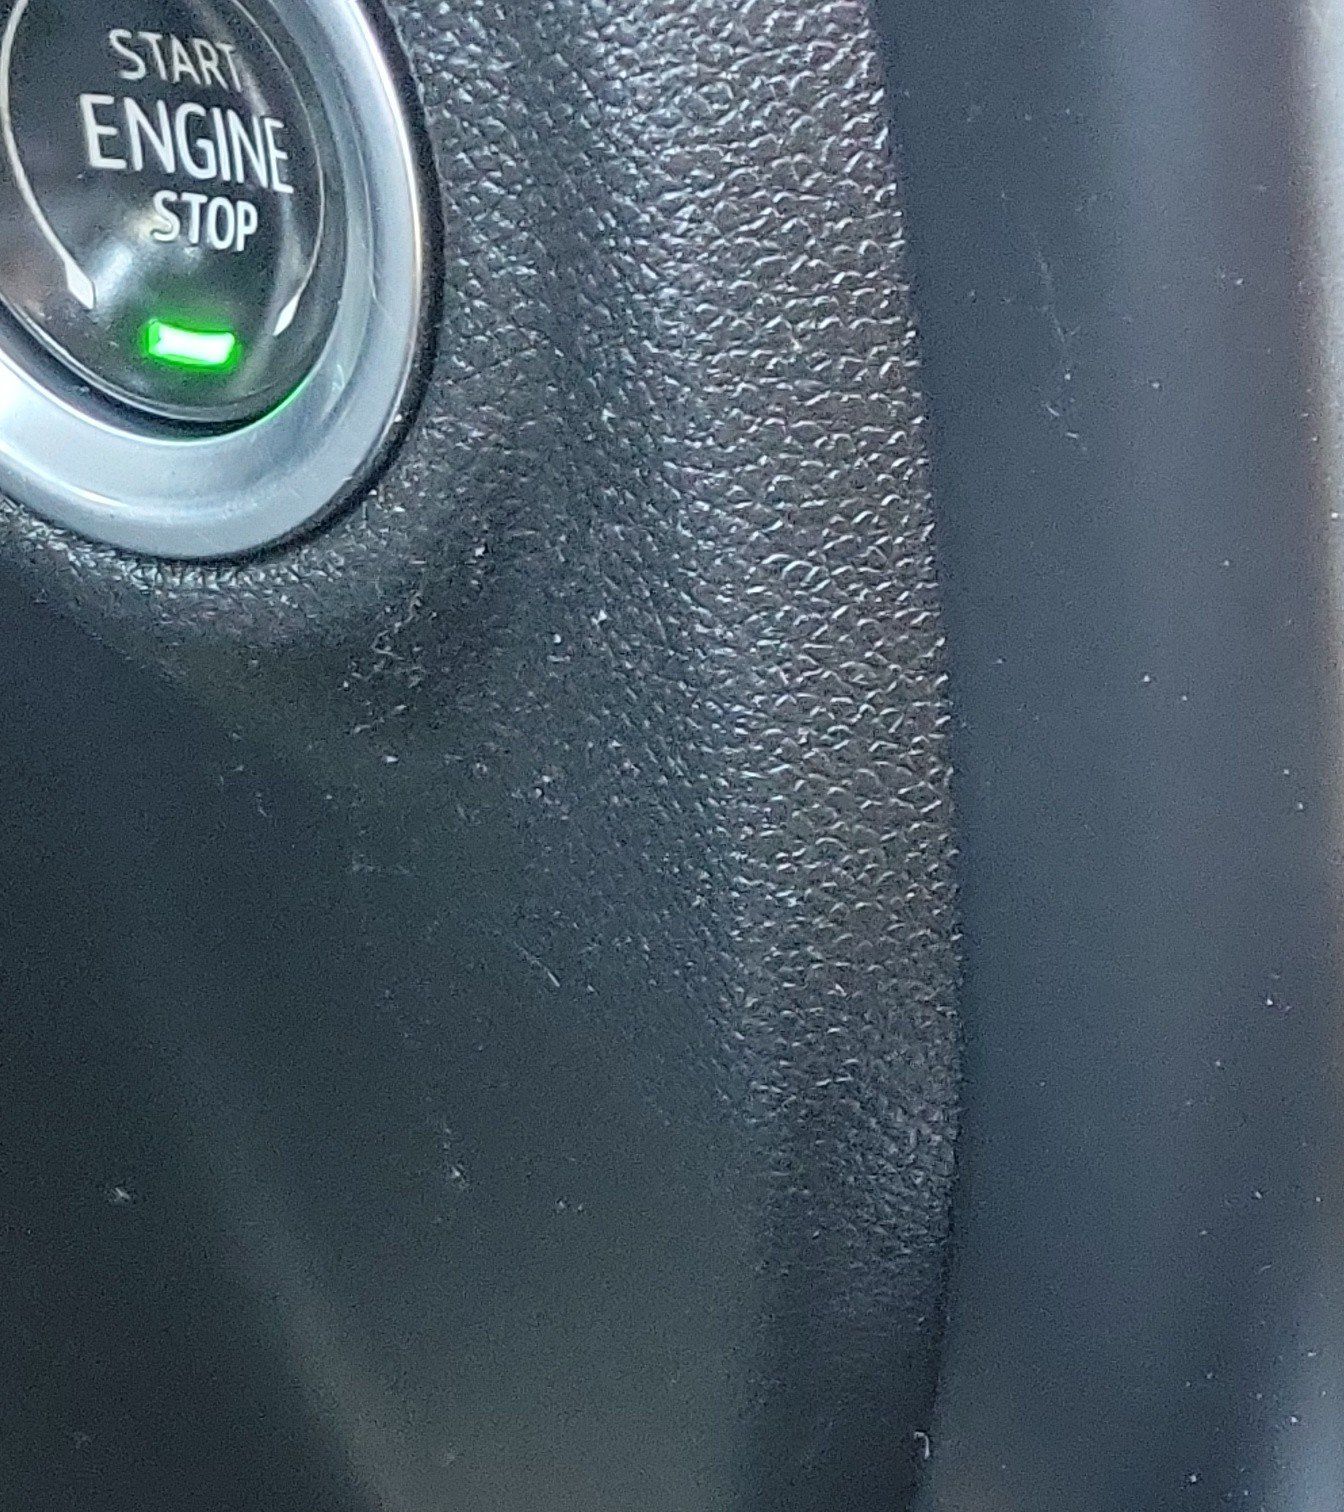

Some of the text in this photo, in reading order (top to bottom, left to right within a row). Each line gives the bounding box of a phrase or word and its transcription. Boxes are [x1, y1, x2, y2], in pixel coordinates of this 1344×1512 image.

[108, 28, 243, 92] START
[79, 93, 294, 194] ENGINE
[150, 189, 259, 252] STOP
